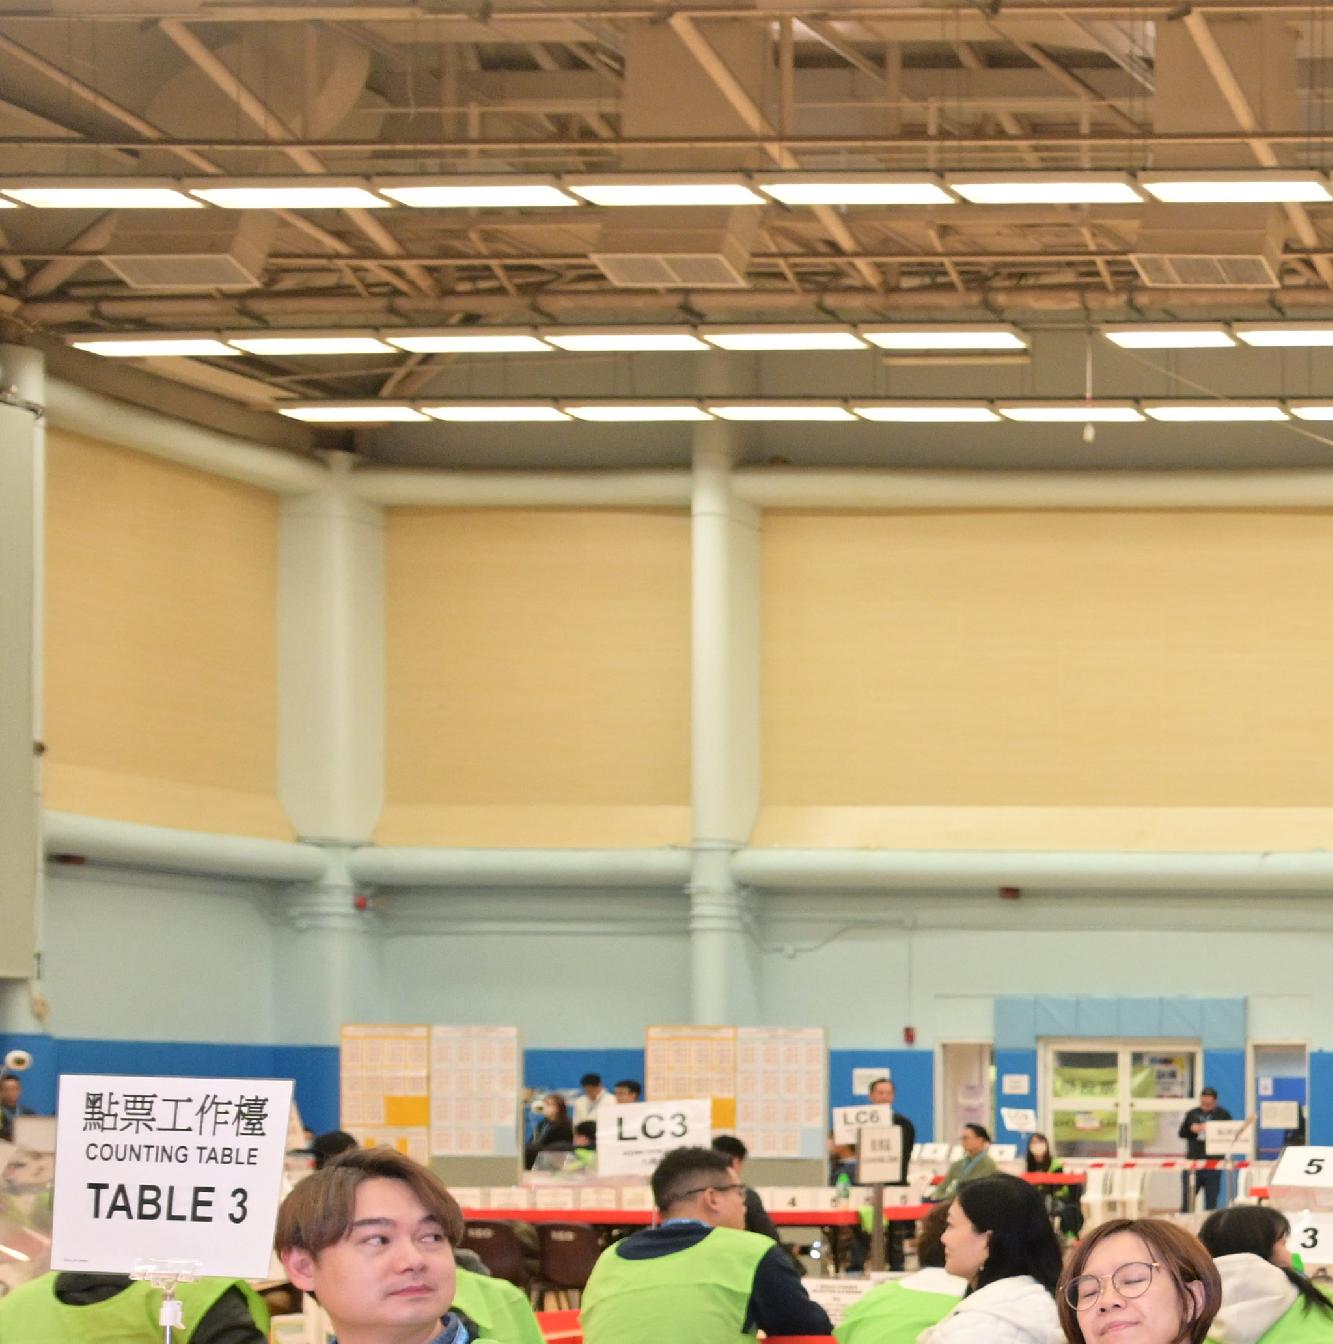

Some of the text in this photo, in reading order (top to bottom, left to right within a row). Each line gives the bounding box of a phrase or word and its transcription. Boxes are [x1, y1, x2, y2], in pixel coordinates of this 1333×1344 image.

[82, 1091, 270, 1138] 點票工作檯
[843, 1108, 880, 1126] LC6
[616, 1112, 688, 1142] LC3
[86, 1143, 259, 1166] COUNTING TABLE
[1304, 1158, 1326, 1176] 5
[87, 1182, 248, 1225] TABLE 3
[1300, 1227, 1319, 1249] 3
